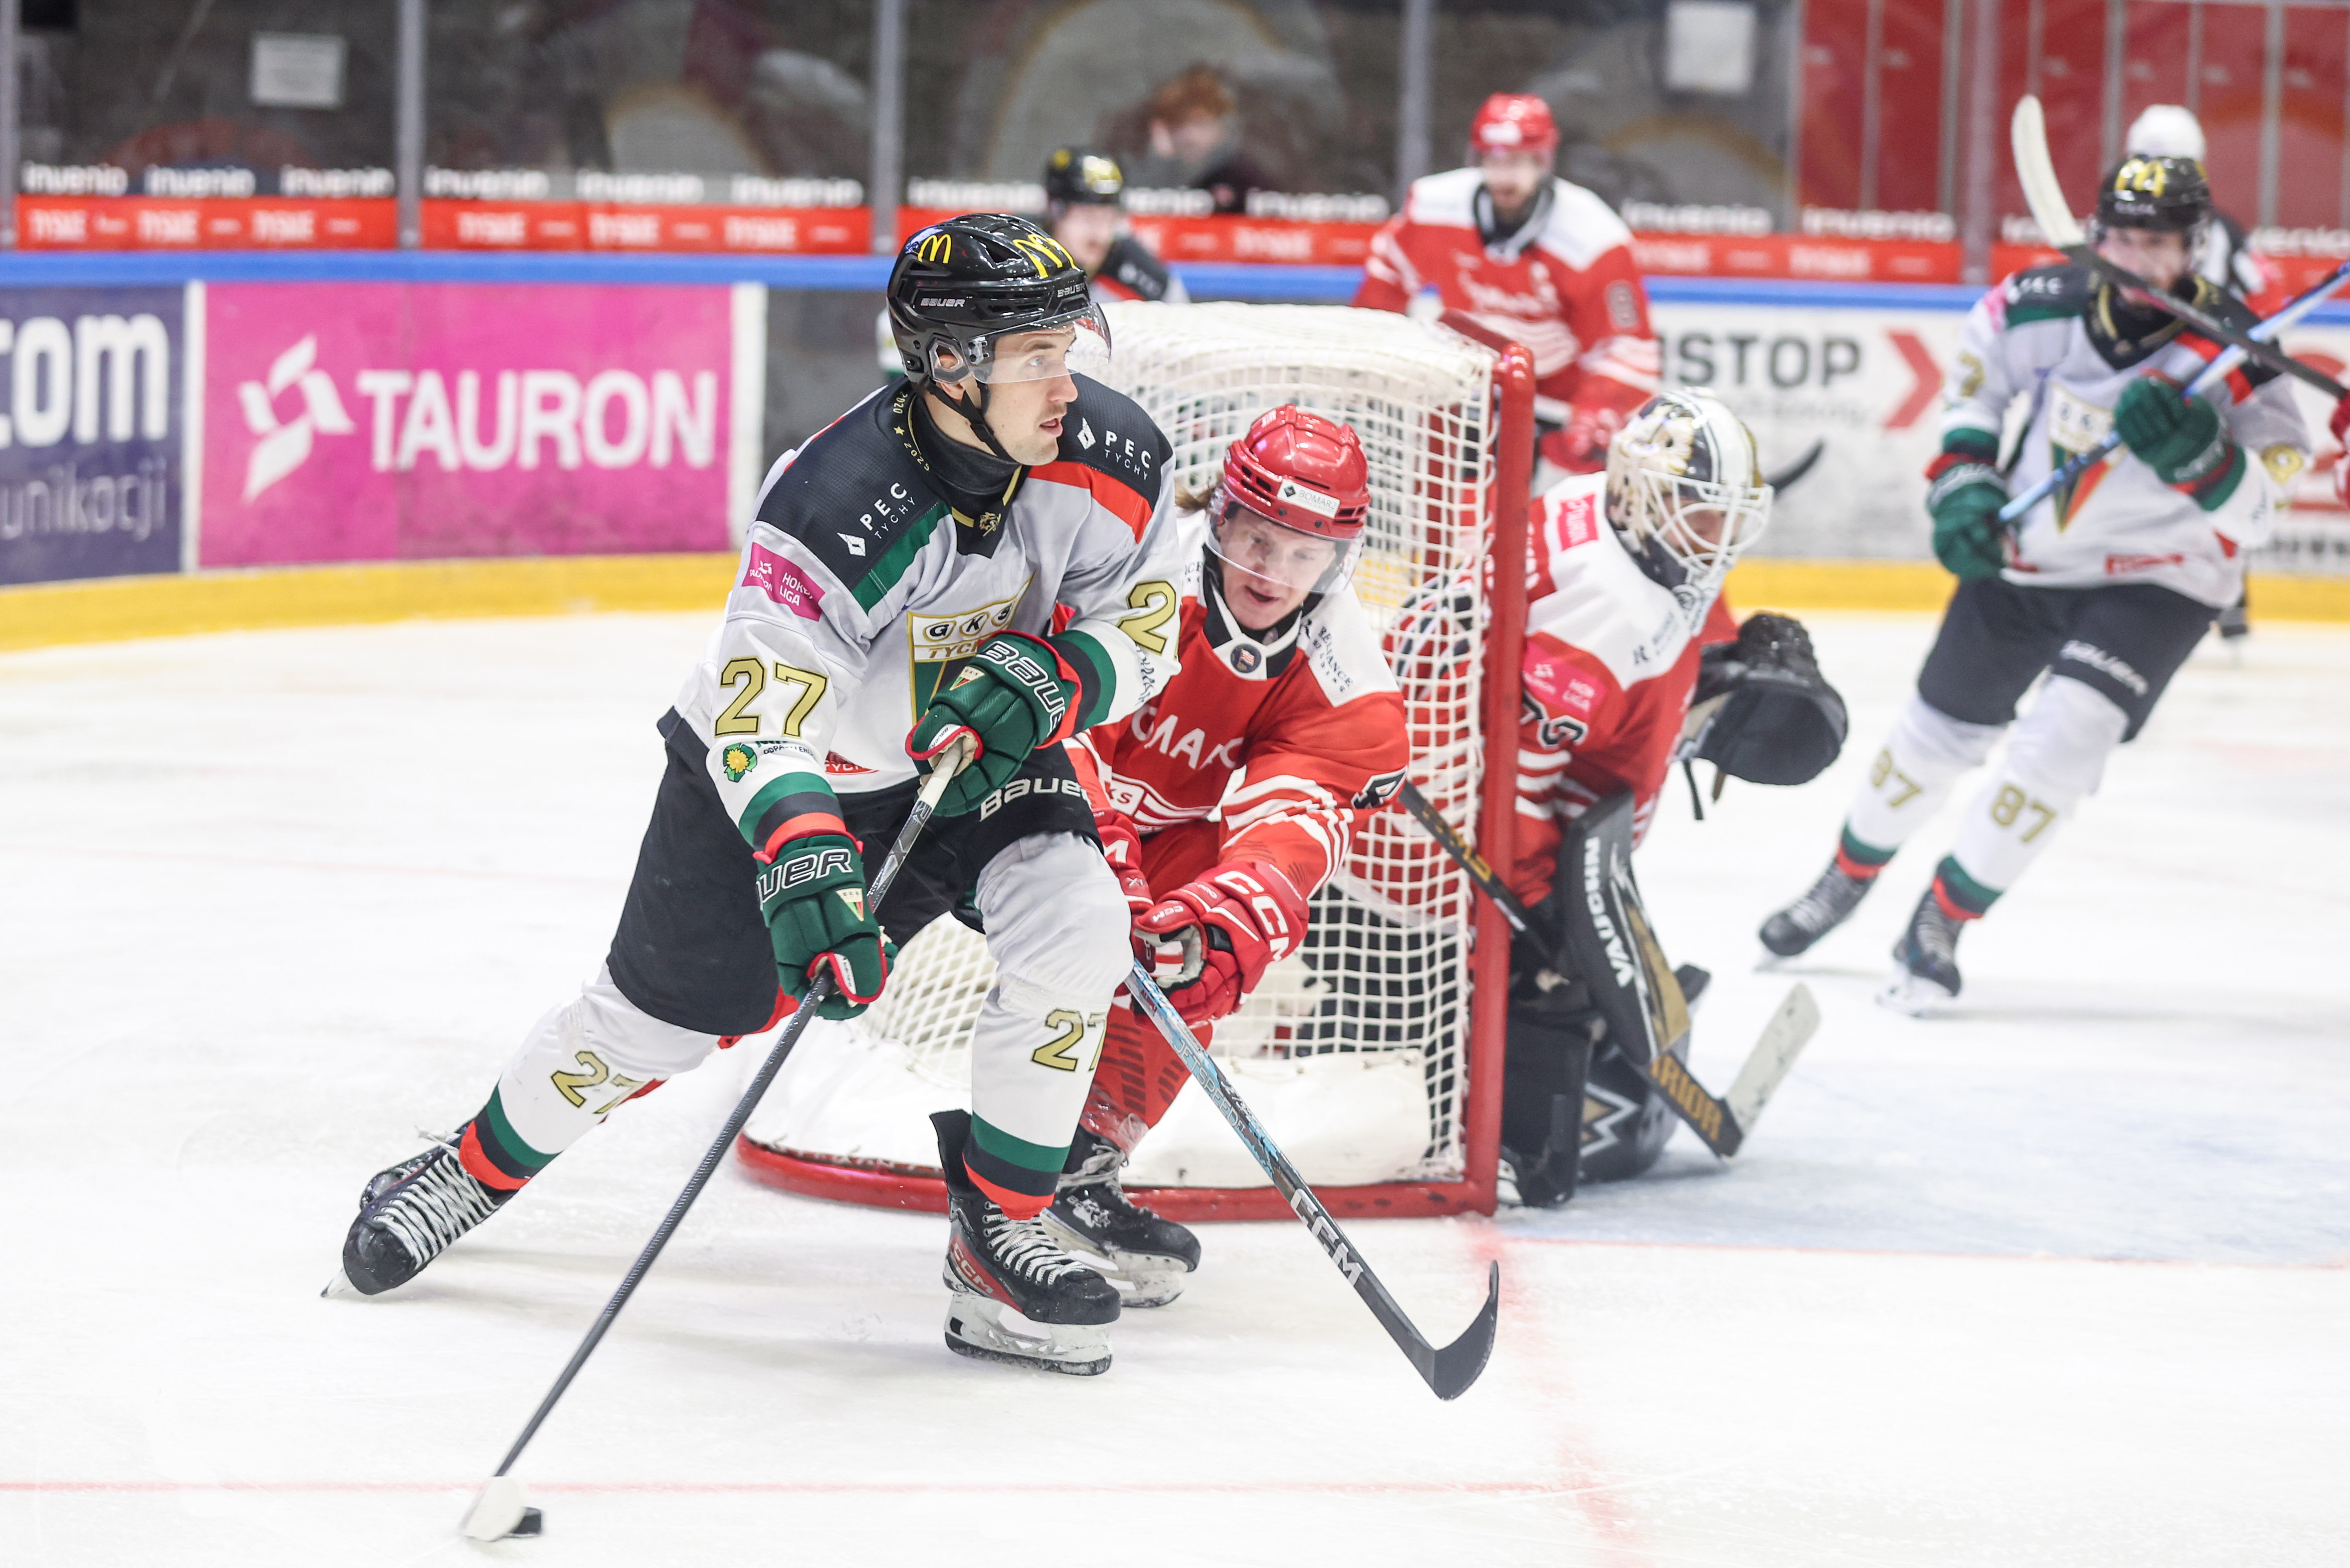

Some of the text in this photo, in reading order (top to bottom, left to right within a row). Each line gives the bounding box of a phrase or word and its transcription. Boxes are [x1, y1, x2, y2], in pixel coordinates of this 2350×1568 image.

[0, 313, 170, 446] om
[1660, 332, 1861, 388] STOP
[355, 368, 719, 472] TAURON
[904, 442, 930, 471] 2025
[1104, 449, 1148, 481] TYCHY
[1105, 430, 1152, 469] PEC
[860, 483, 907, 531] PEC
[874, 496, 916, 540] TYCHY
[780, 585, 800, 606] LIGA
[782, 572, 813, 599] HOKE
[714, 656, 829, 739] 27
[1990, 783, 2057, 843] 87
[756, 849, 853, 911] UER
[1152, 904, 1184, 923] CCM
[1583, 837, 1634, 988] VAUGHN
[551, 1050, 646, 1114] 27
[1174, 1038, 1239, 1127] JETSPEED
[1291, 1188, 1364, 1288] CCM
[954, 1243, 994, 1294] CCM
